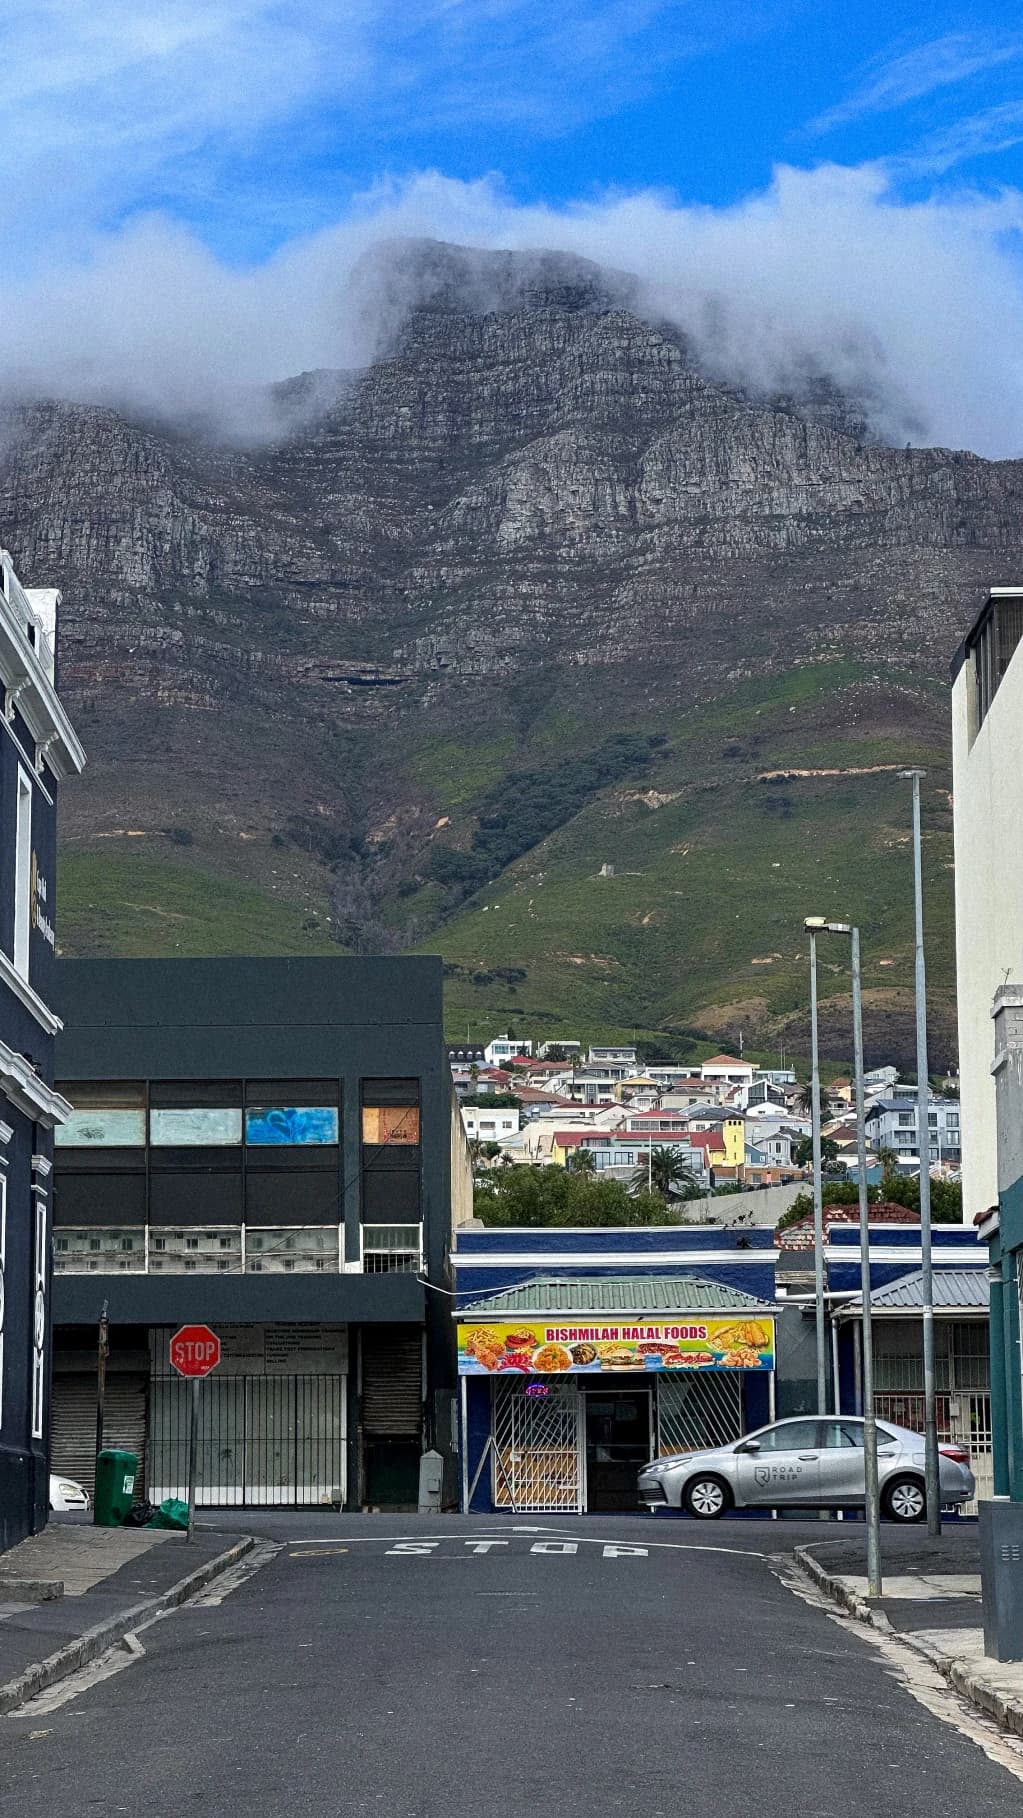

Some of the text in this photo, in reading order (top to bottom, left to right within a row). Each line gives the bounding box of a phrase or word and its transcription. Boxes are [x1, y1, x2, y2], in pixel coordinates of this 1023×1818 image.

[546, 1326, 707, 1341] BISHMILAH HALAL FOODS
[175, 1341, 215, 1361] STOP
[384, 1540, 649, 1557] STOP
